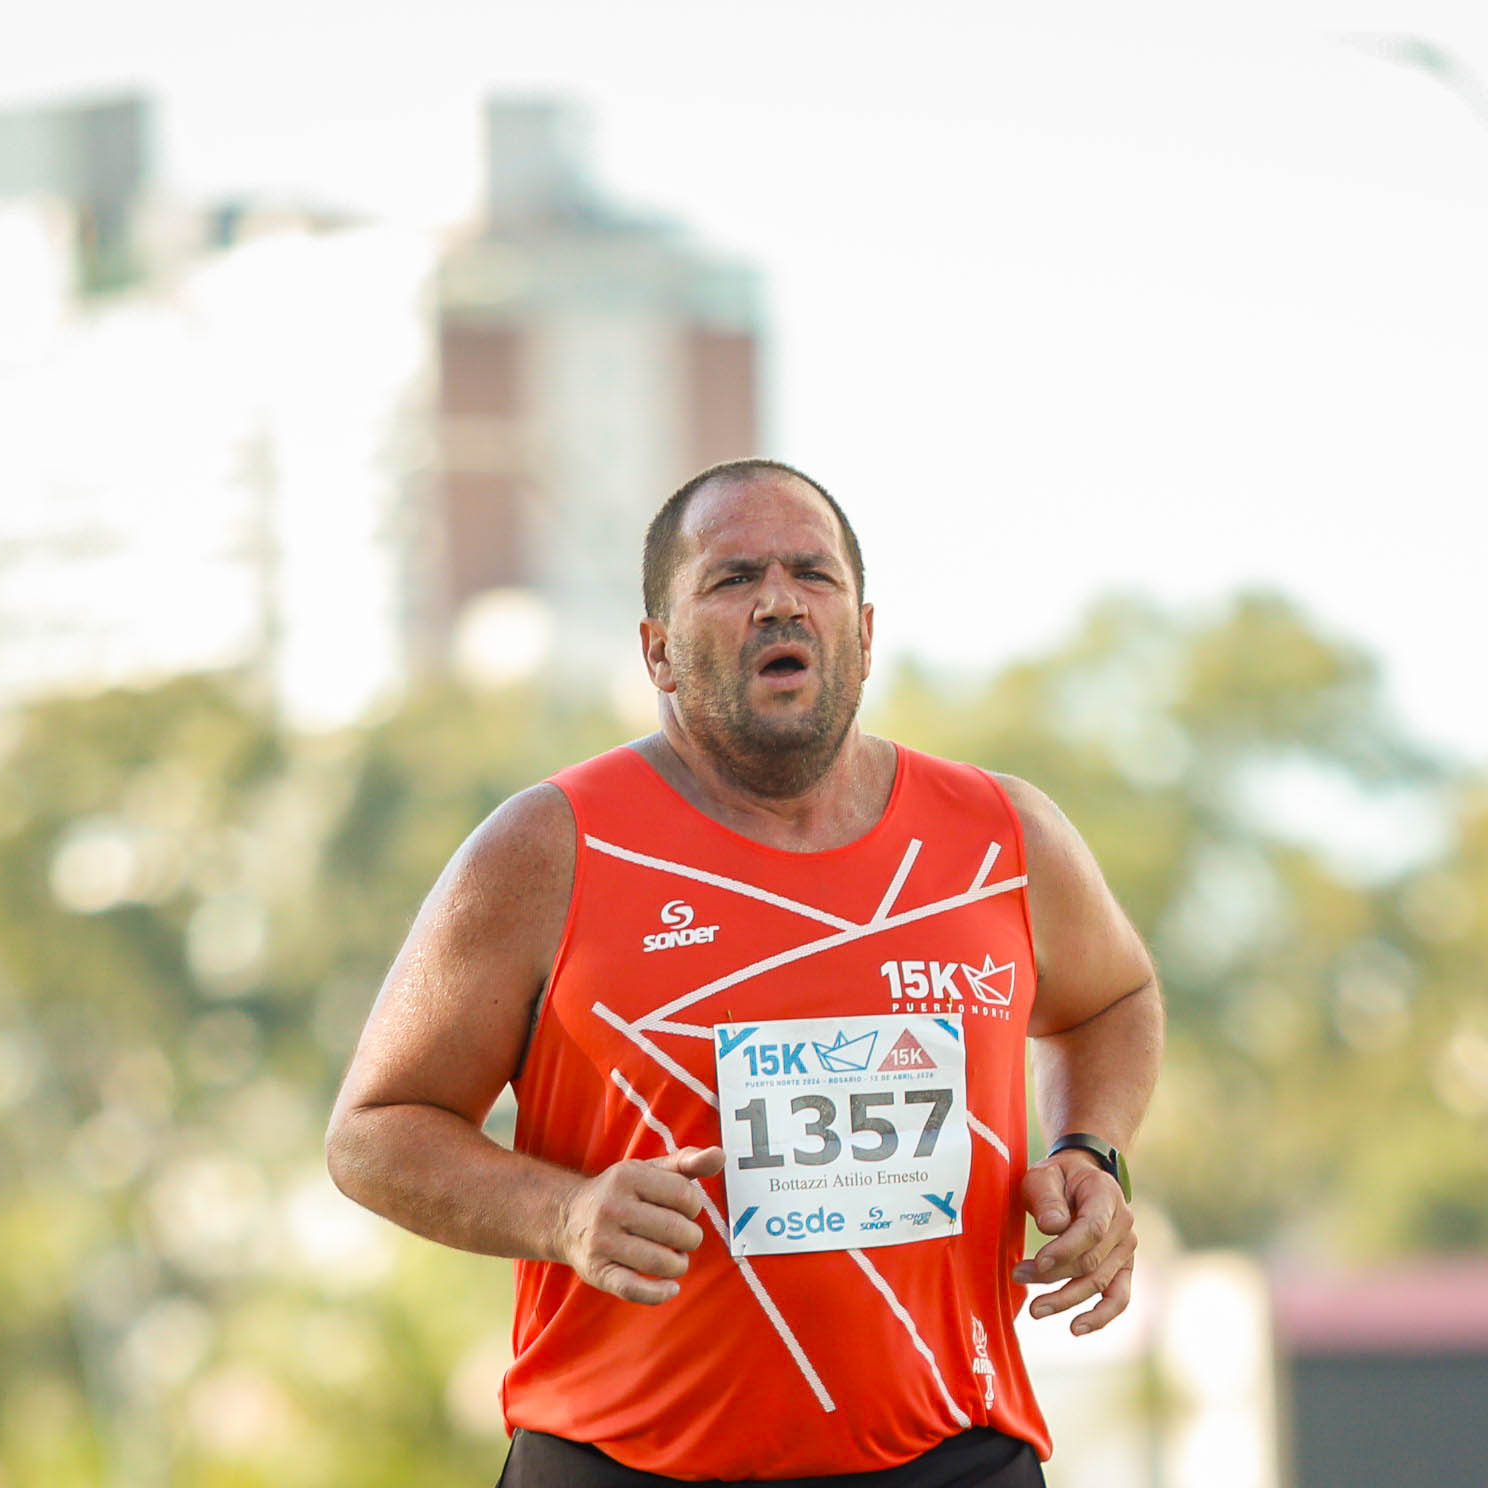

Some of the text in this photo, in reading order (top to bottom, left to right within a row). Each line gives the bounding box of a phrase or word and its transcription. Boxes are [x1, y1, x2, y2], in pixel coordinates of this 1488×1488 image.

[880, 961, 963, 1000] 15K
[892, 1003, 1010, 1020] PUERTO NORTE
[743, 1042, 809, 1076] 15K
[891, 1048, 924, 1066] 15K
[745, 1079, 774, 1088] PUERTO
[776, 1078, 800, 1087] NORTE
[828, 1075, 862, 1084] ROSARIO
[881, 1073, 890, 1081] DE
[893, 1072, 913, 1080] ABRIL
[735, 1088, 954, 1170] 1357
[769, 1170, 929, 1192] Bottazzi Atilio Ernesto
[766, 1206, 846, 1240] osde
